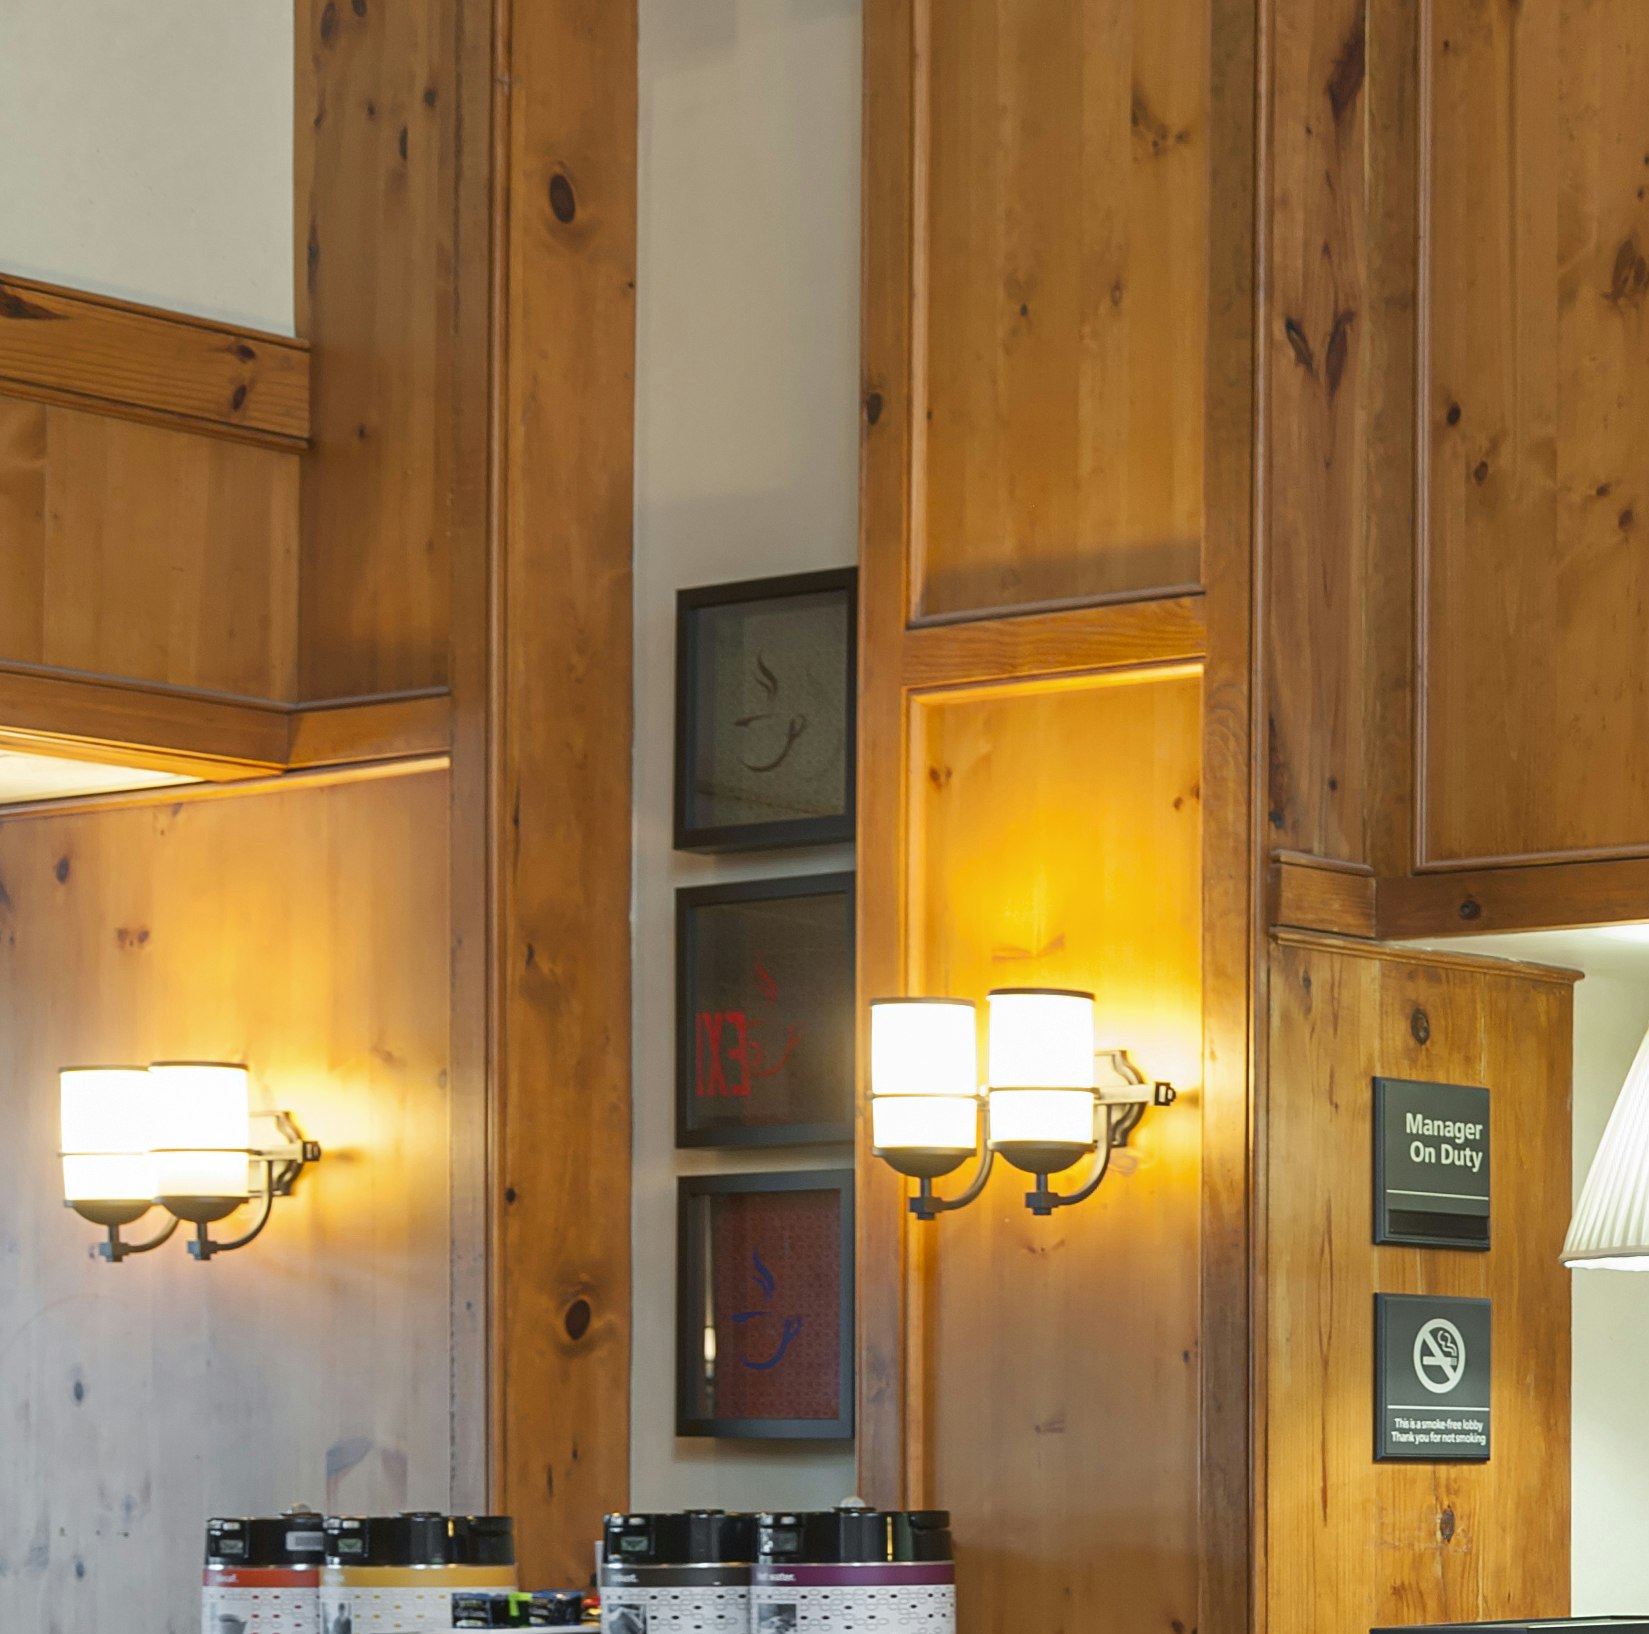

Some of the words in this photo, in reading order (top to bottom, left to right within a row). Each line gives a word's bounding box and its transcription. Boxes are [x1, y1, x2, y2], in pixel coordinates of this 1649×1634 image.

[1405, 1112, 1483, 1144] Manager
[1409, 1141, 1436, 1163] On
[1440, 1143, 1483, 1172] Duty
[1394, 1418, 1409, 1429] This
[1410, 1418, 1416, 1429] is
[1416, 1421, 1421, 1429] a
[1422, 1418, 1462, 1430] smoke-free
[1463, 1419, 1483, 1432] lobby
[1391, 1431, 1414, 1442] Thank
[1414, 1434, 1429, 1445] you
[1430, 1431, 1441, 1442] for
[1442, 1433, 1455, 1443] not
[1455, 1432, 1487, 1446] smoking
